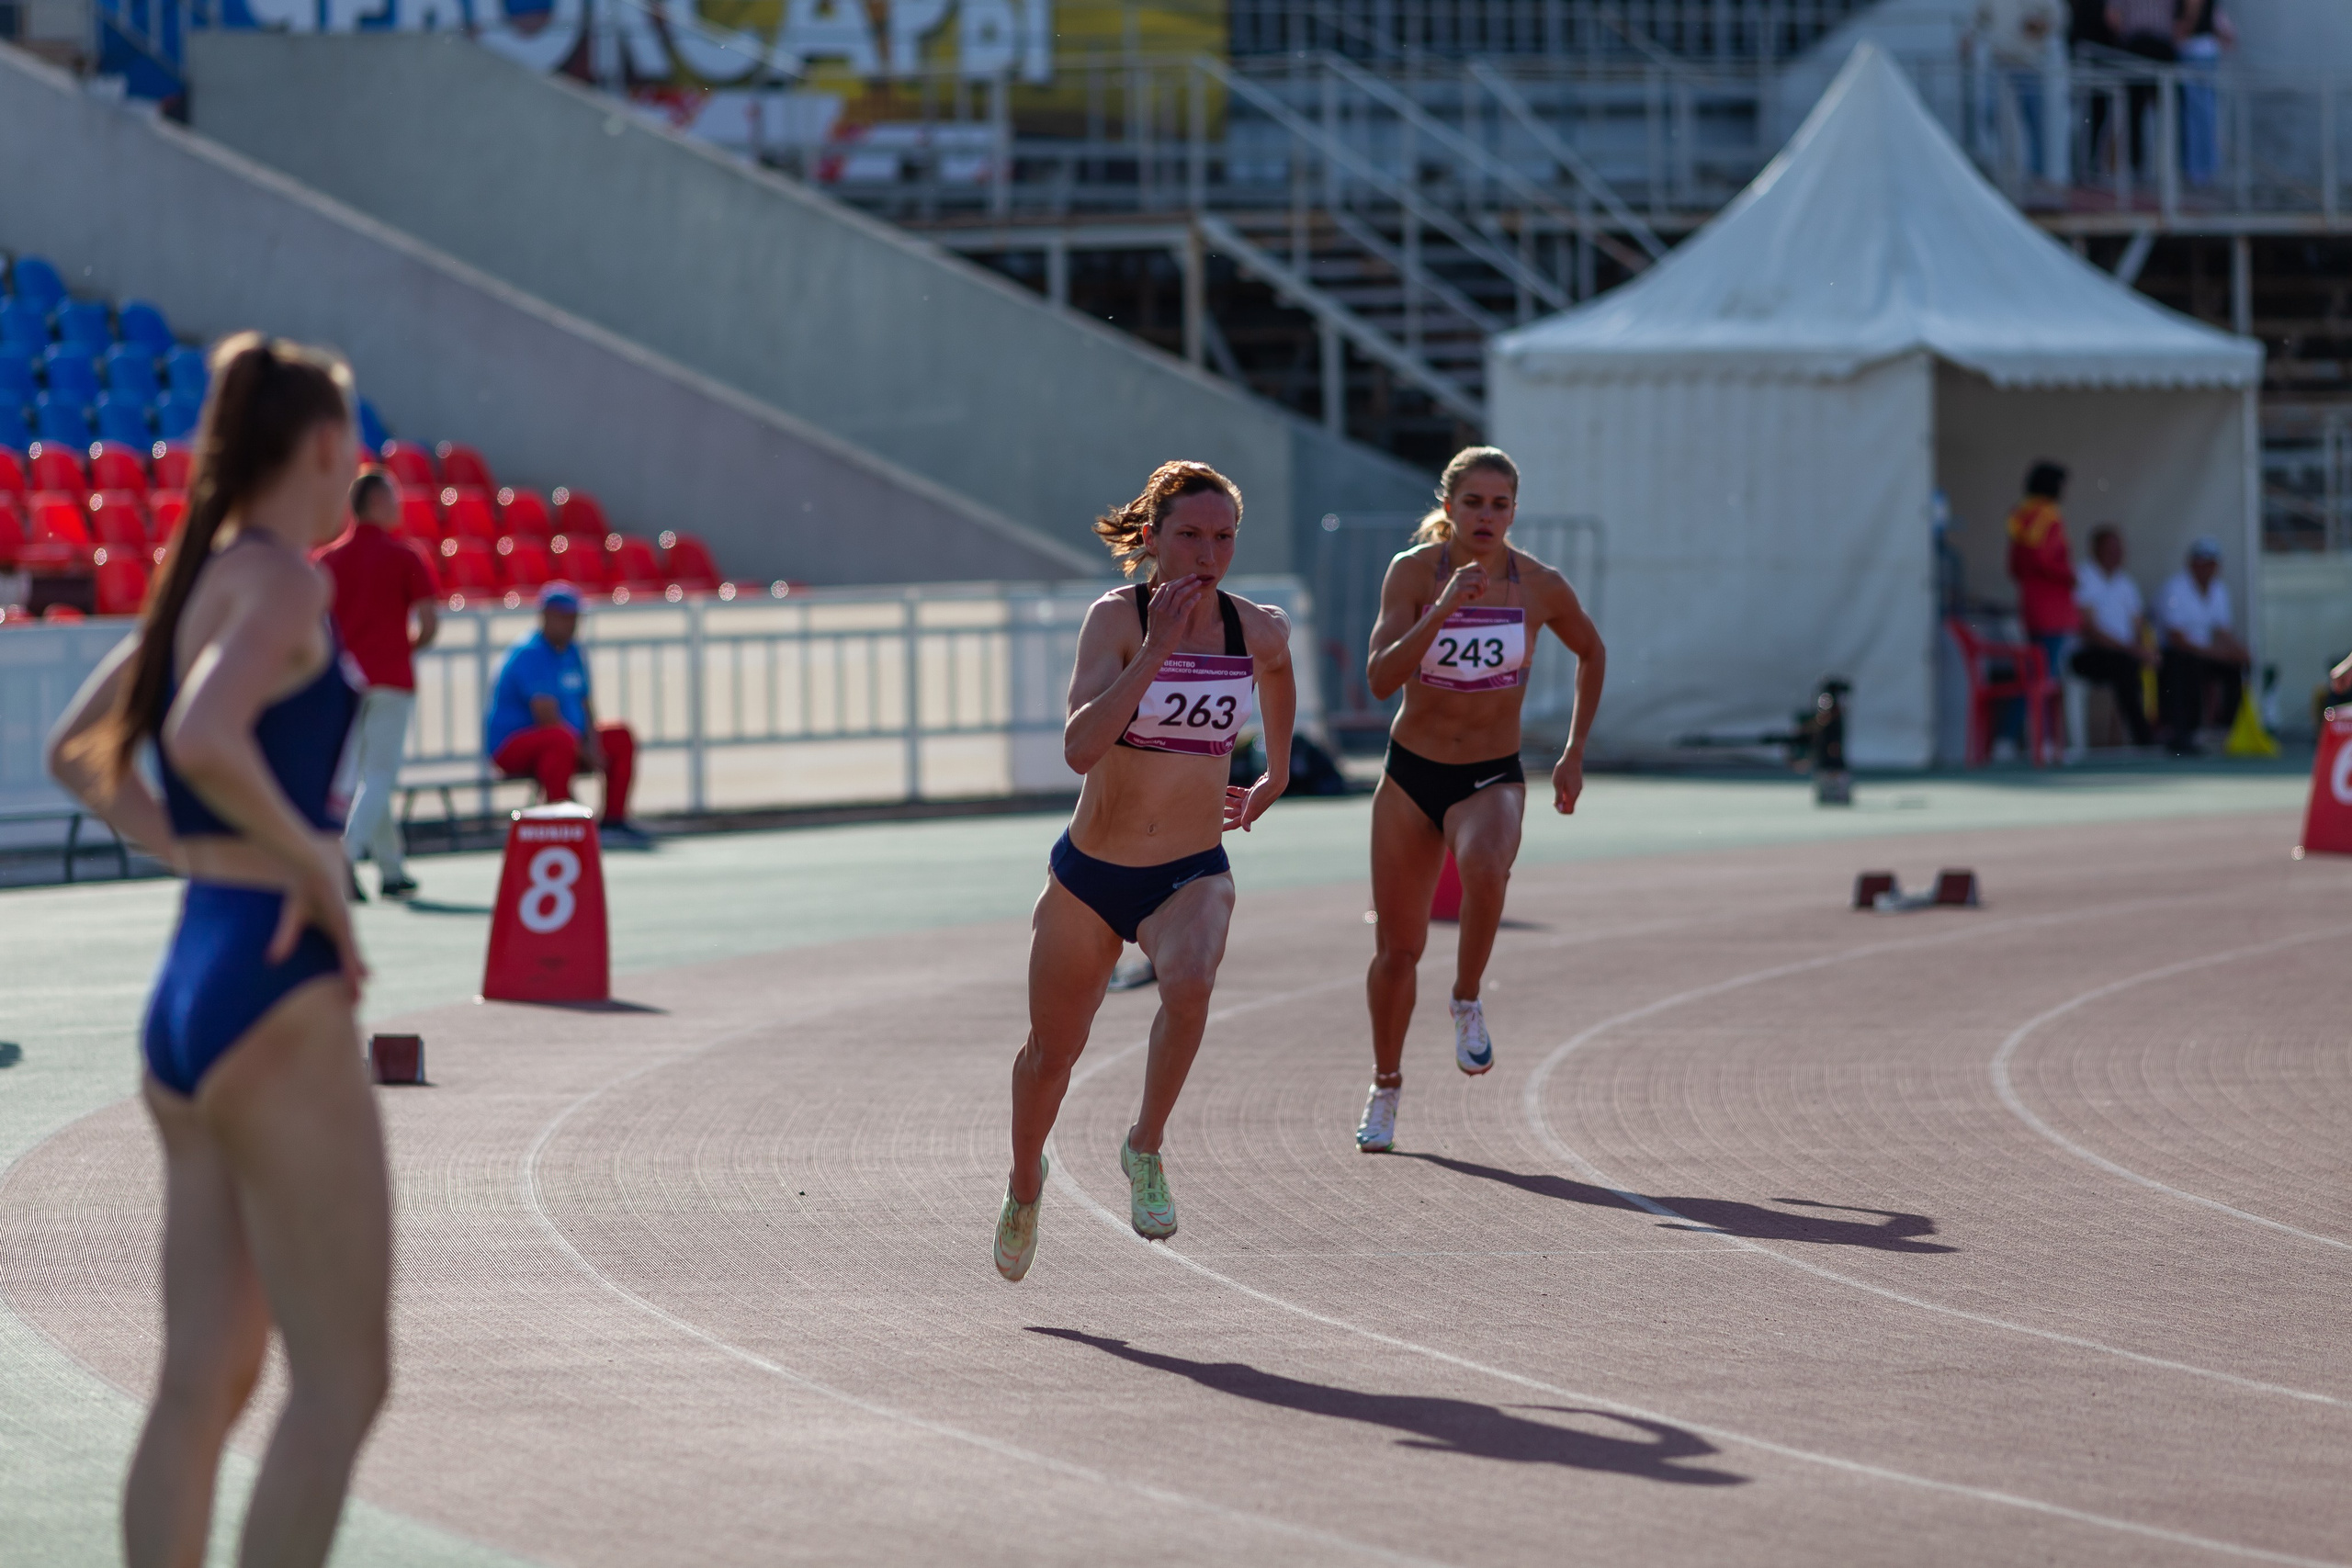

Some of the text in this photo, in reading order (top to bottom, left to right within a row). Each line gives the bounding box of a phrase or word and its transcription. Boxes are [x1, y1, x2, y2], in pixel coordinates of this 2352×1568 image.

[244, 0, 1054, 83] ОКСАРЫ
[1437, 637, 1504, 668] 243
[1158, 693, 1237, 729] 263
[518, 846, 582, 934] 8
